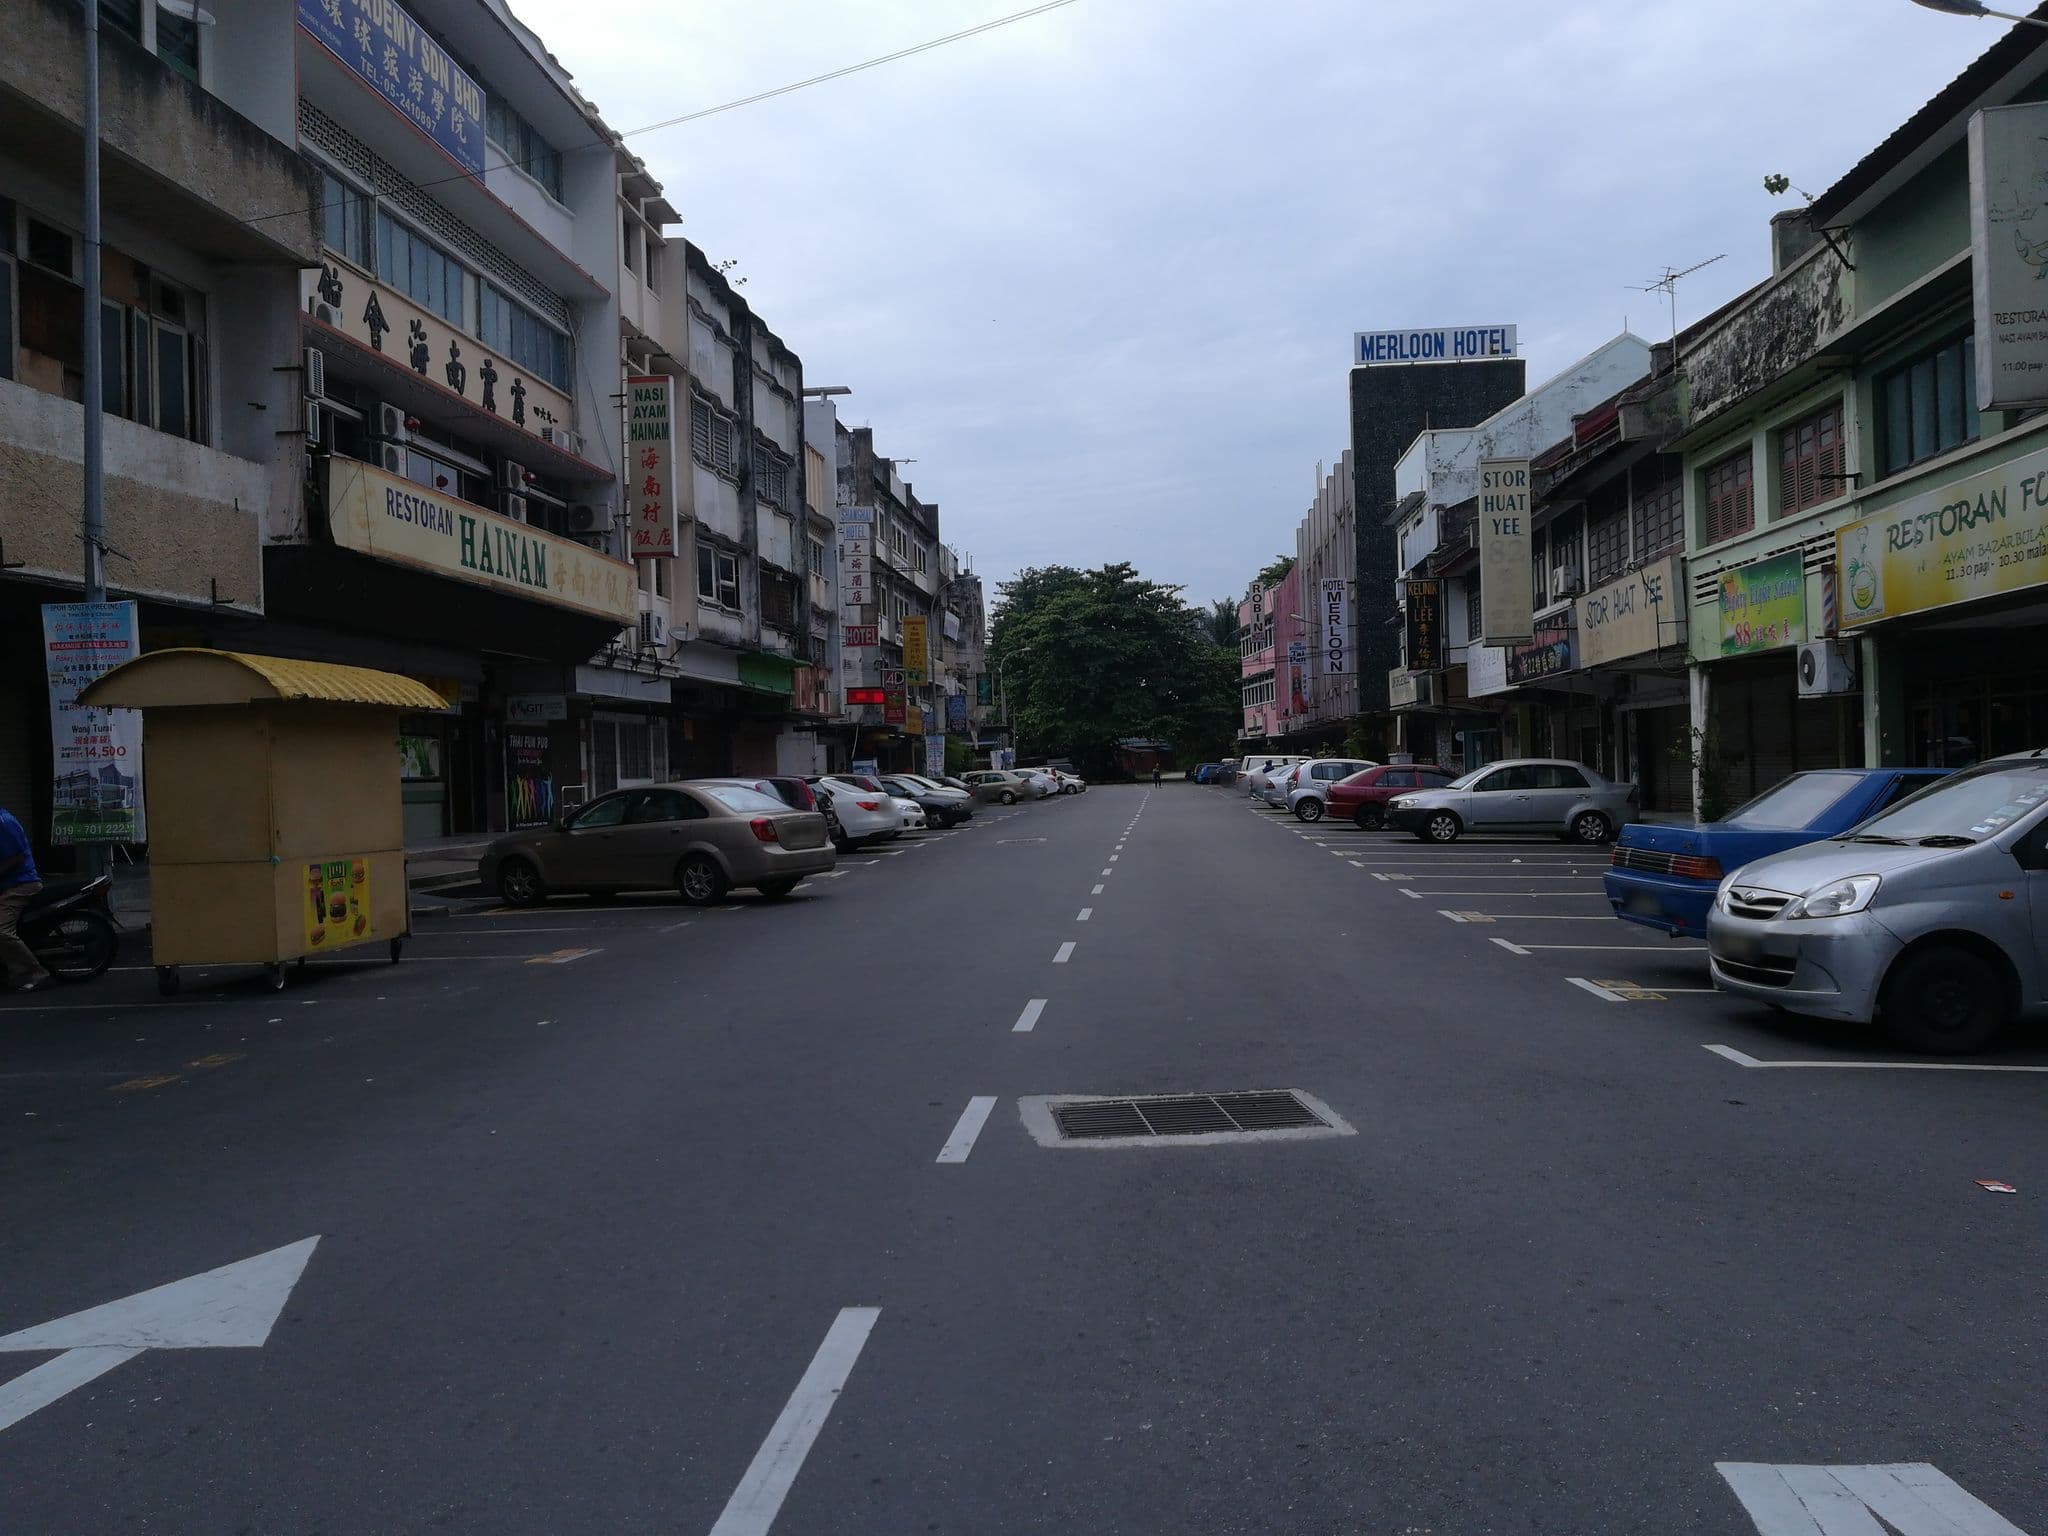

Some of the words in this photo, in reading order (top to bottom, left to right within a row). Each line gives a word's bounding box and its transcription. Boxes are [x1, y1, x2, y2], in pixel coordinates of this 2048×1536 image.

[421, 37, 449, 93] SDN
[454, 70, 480, 122] BHD
[1361, 332, 1445, 361] MERLOON
[1454, 328, 1511, 356] HOTEL
[635, 388, 663, 401] NASI
[633, 405, 666, 419] AYAM
[631, 422, 669, 441] HAINAM
[1483, 470, 1526, 488] STOR
[1484, 494, 1526, 512] HUAT
[1492, 518, 1520, 535] YEE
[1887, 485, 2007, 553] RESTORAN
[386, 487, 453, 536] RESTORAN
[459, 514, 548, 590] HAINAM
[846, 525, 864, 538] HOTEL
[1943, 547, 1976, 565] AYAM
[1978, 535, 2013, 556] BAZAR
[1974, 557, 1990, 579] pagi
[1999, 551, 2025, 567] 10.30
[1322, 580, 1345, 591] HOTEL
[1252, 584, 1264, 632] ROBIN
[1585, 595, 1609, 630] STOR
[1613, 584, 1636, 620] HUAT
[1644, 576, 1663, 609] YEE
[1414, 609, 1432, 622] LEE
[846, 628, 878, 645] HOTEL
[1327, 592, 1343, 672] MERLOON
[1735, 621, 1751, 647] 88
[55, 825, 74, 836] 019
[84, 824, 102, 834] 701
